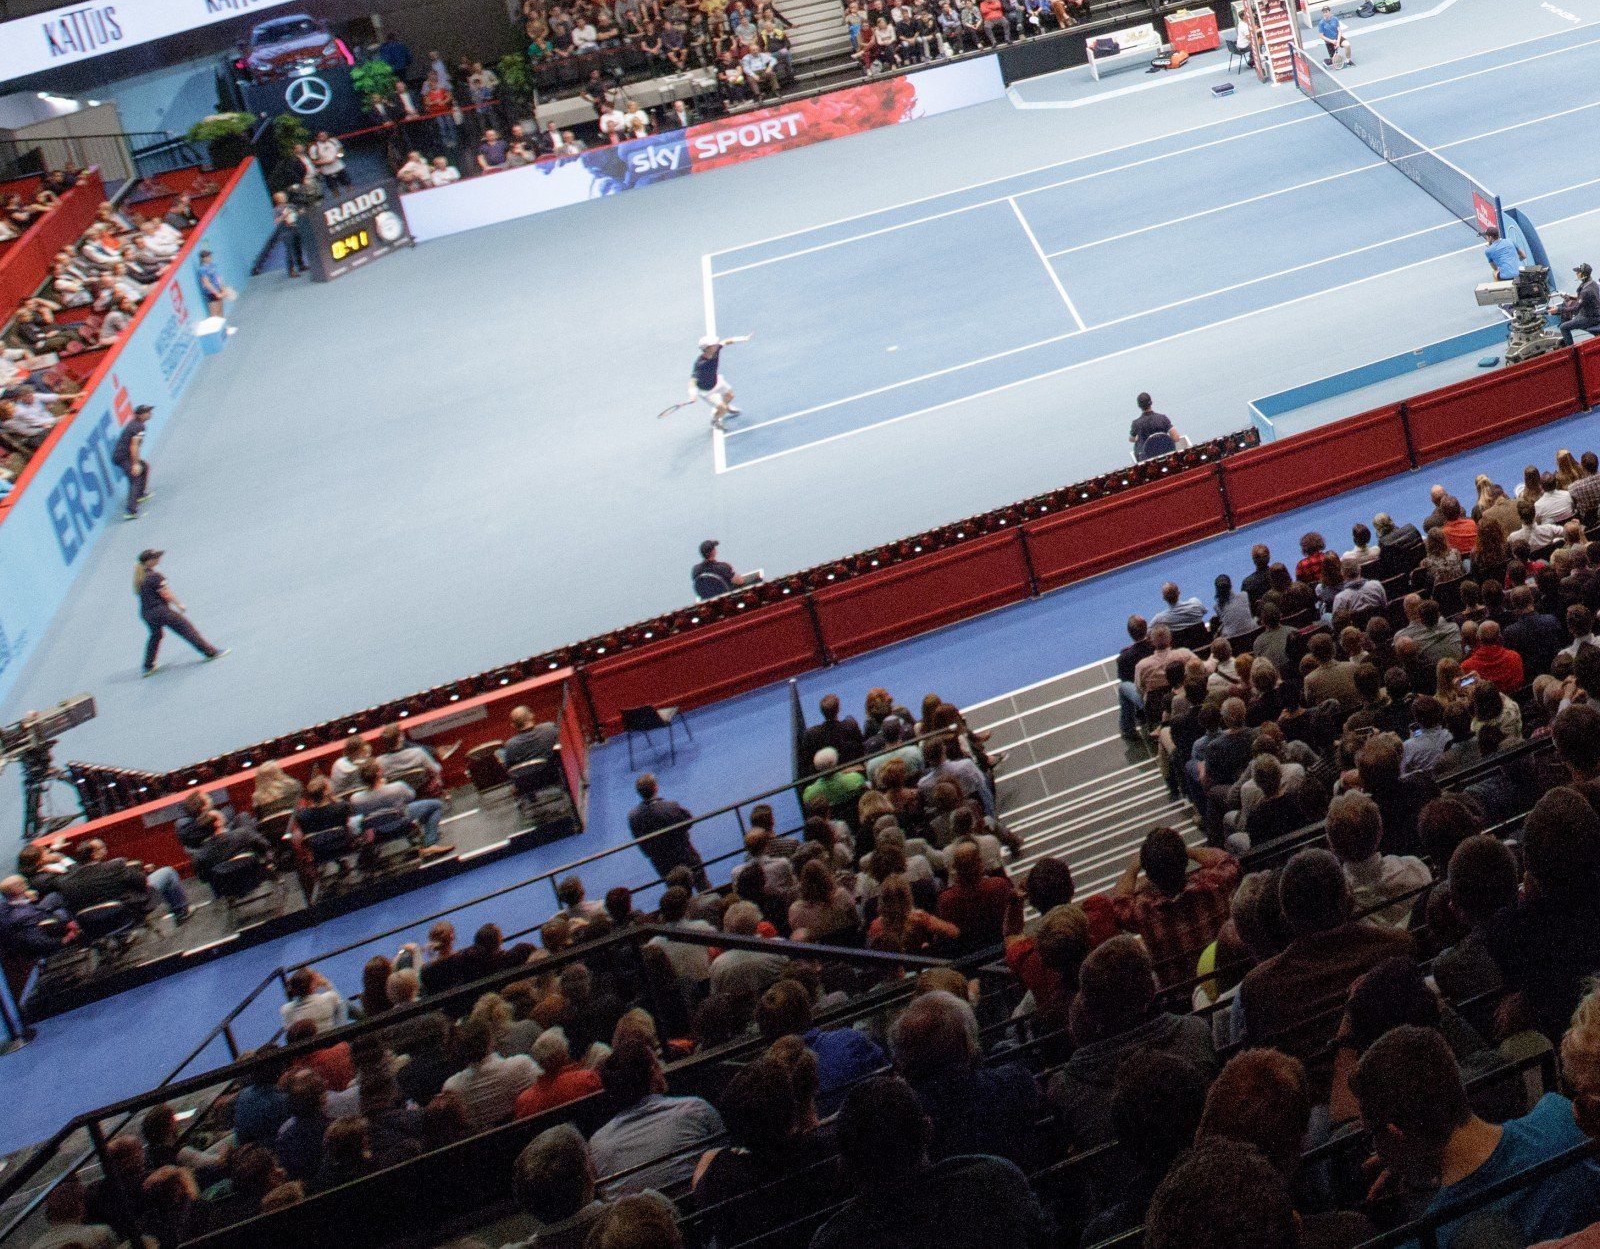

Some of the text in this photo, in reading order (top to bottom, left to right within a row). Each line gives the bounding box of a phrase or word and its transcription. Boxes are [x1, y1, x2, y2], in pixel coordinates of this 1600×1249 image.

[42, 5, 123, 57] KATTUS
[632, 113, 802, 173] sky SPORT
[323, 188, 387, 226] RADO
